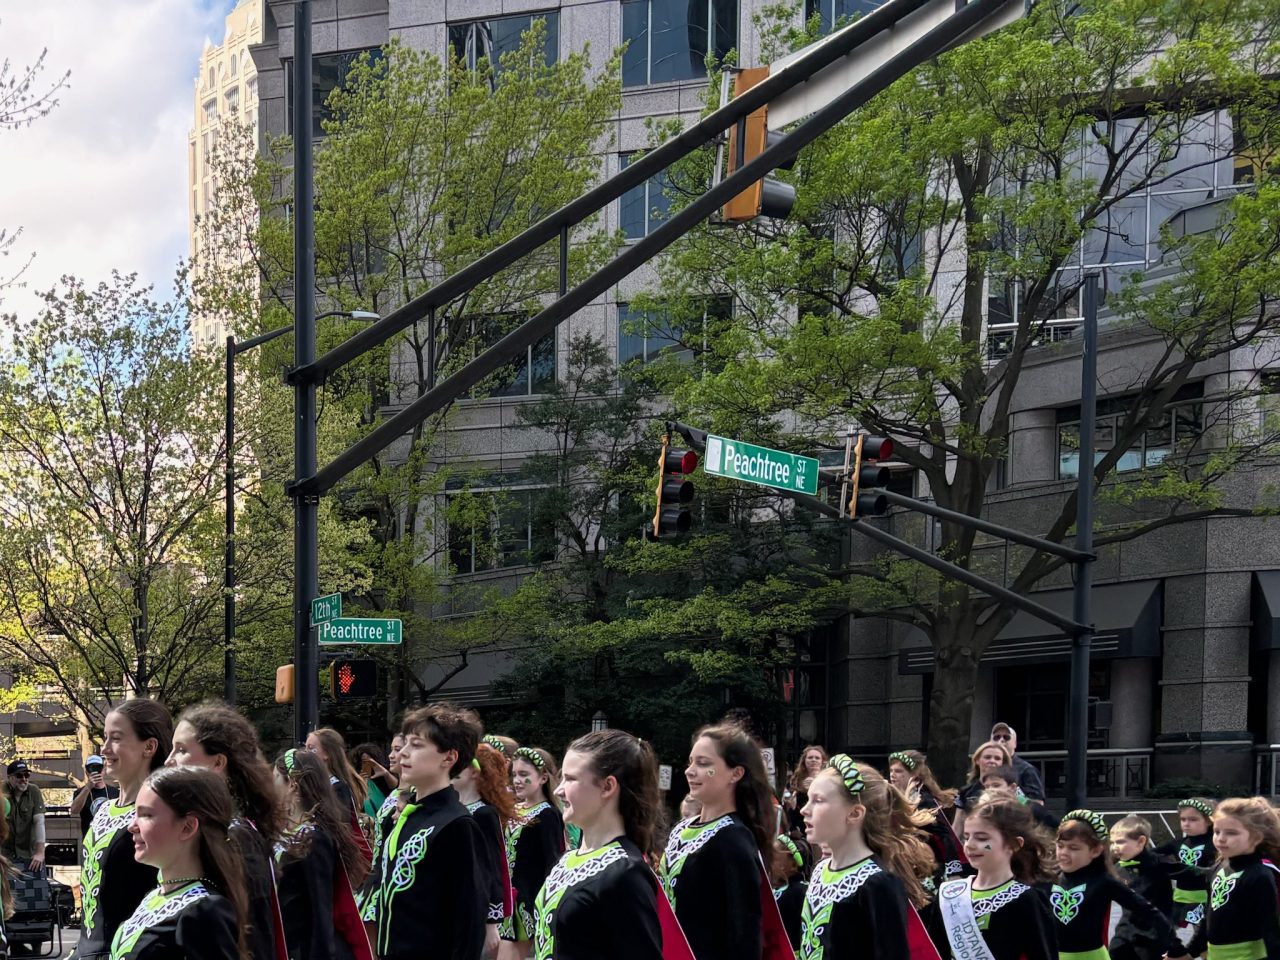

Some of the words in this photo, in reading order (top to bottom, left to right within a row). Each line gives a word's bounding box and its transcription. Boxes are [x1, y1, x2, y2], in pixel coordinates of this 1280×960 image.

[724, 446, 790, 484] Peachtree
[796, 459, 807, 474] ST
[795, 474, 805, 490] NE
[314, 602, 331, 620] 12th
[331, 596, 338, 605] ST
[323, 622, 383, 639] Peachtree
[386, 621, 395, 630] ST
[386, 632, 395, 642] NE
